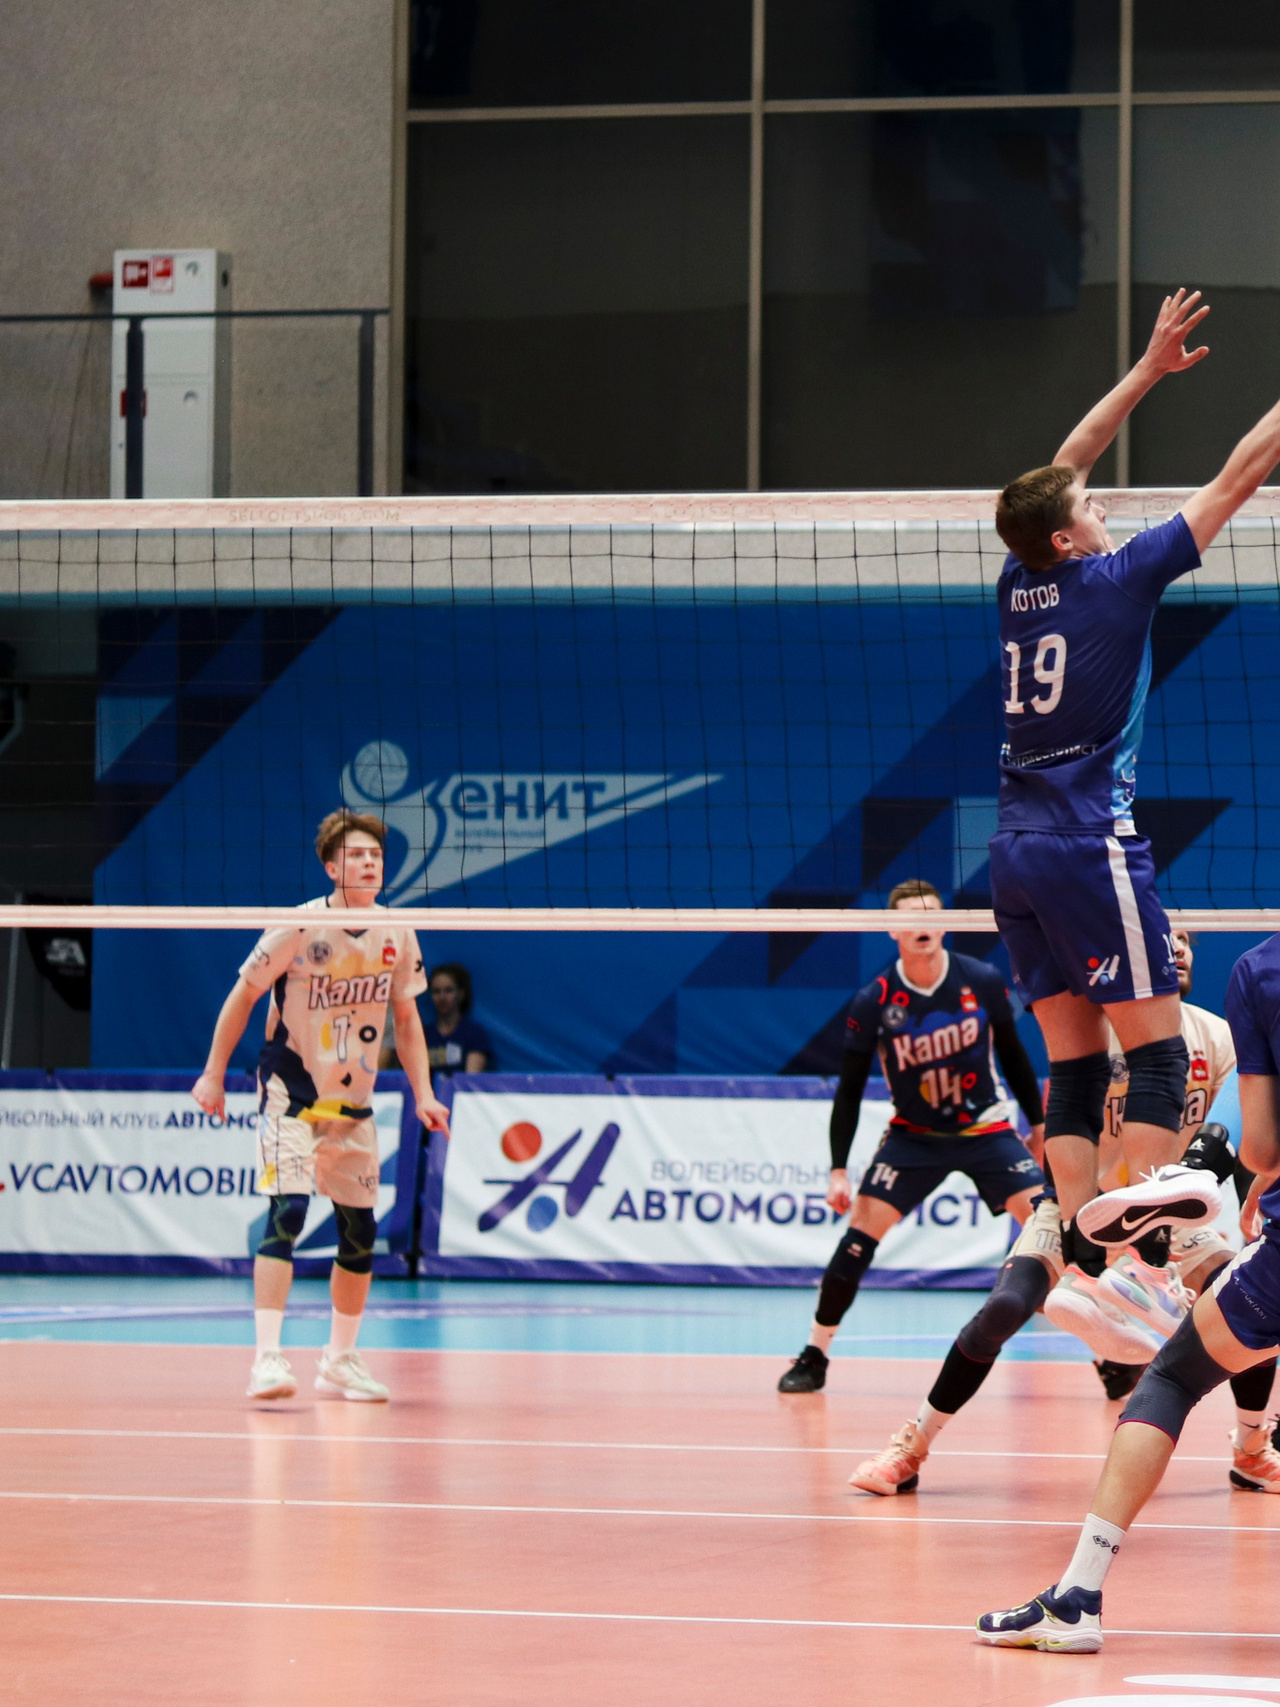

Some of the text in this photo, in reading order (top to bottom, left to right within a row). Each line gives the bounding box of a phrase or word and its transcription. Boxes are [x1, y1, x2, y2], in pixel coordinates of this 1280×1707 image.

[1011, 583, 1060, 612] КОТОВ
[1004, 634, 1067, 714] 19
[309, 971, 392, 1010] Kama
[893, 1016, 978, 1072] Kama
[922, 1067, 962, 1109] 14
[163, 1110, 262, 1131] АВТОМО
[10, 1163, 263, 1197] VCAVTOMOBIL
[871, 1163, 900, 1190] 14
